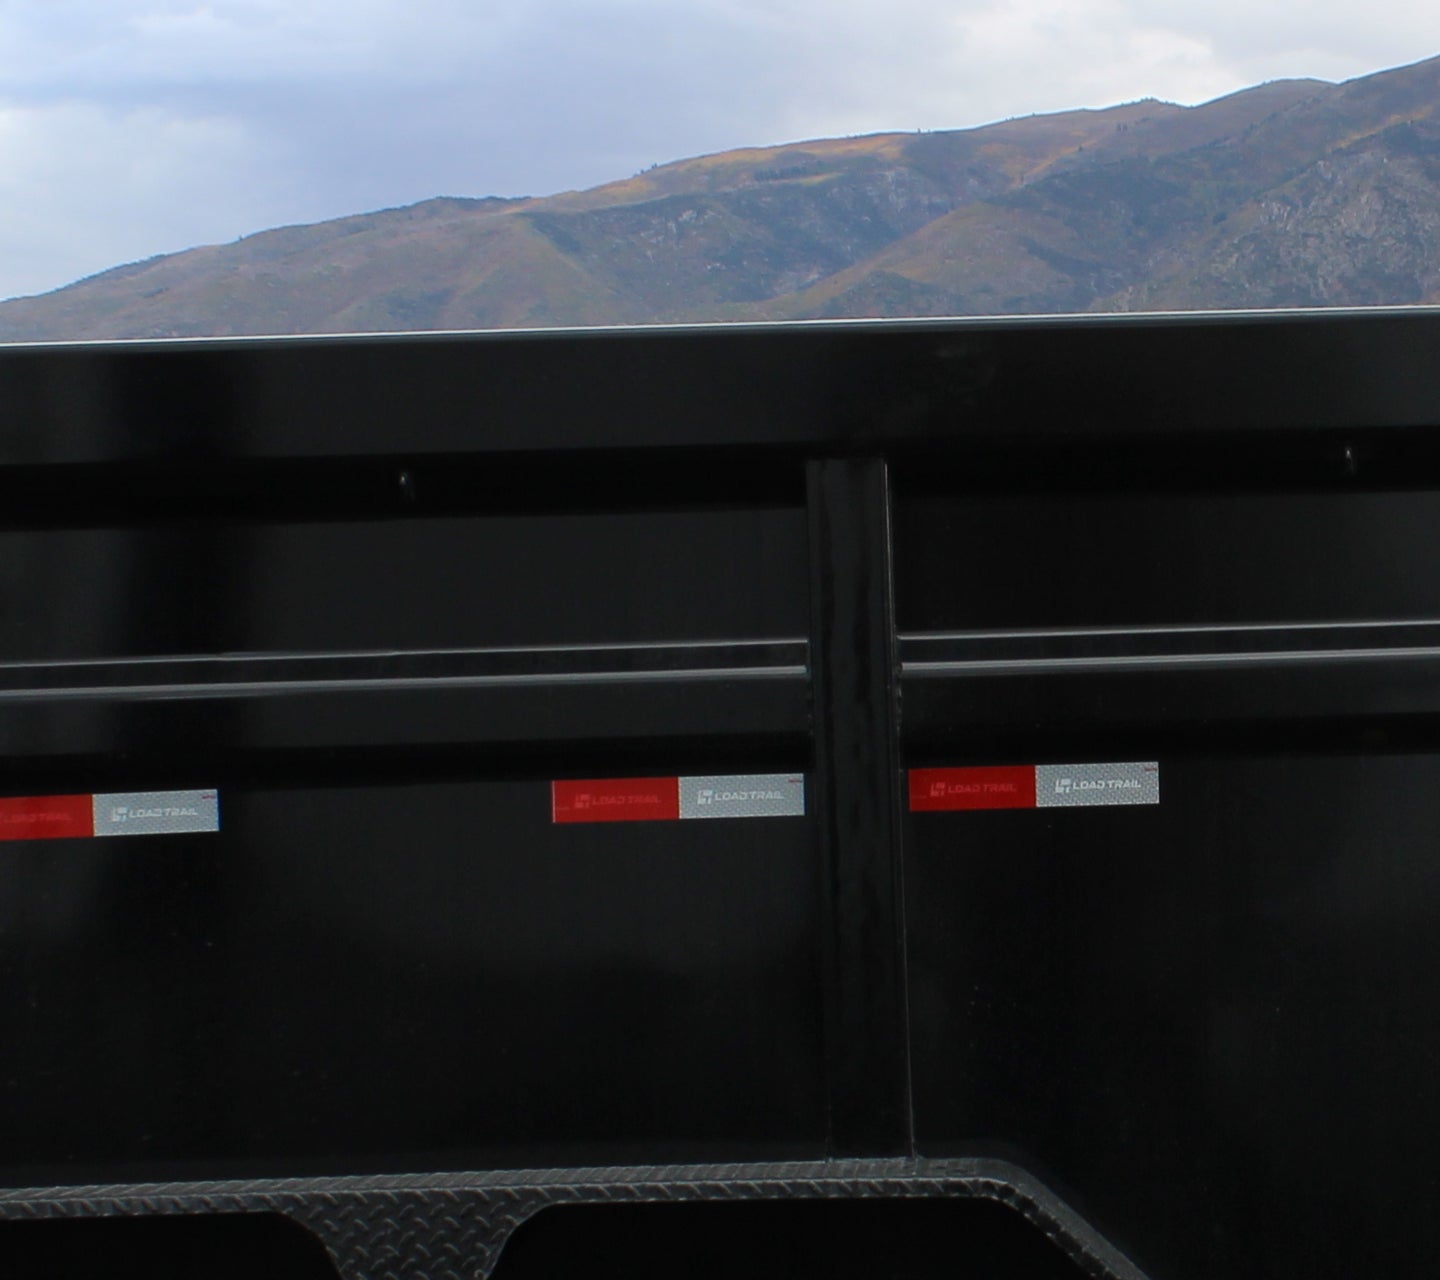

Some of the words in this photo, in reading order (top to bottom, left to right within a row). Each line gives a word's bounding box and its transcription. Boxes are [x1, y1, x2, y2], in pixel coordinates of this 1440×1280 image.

[1073, 780, 1107, 790] LOAD
[1108, 778, 1141, 789] TRAIL
[714, 791, 749, 801] LOAD
[750, 790, 784, 800] TRAIL
